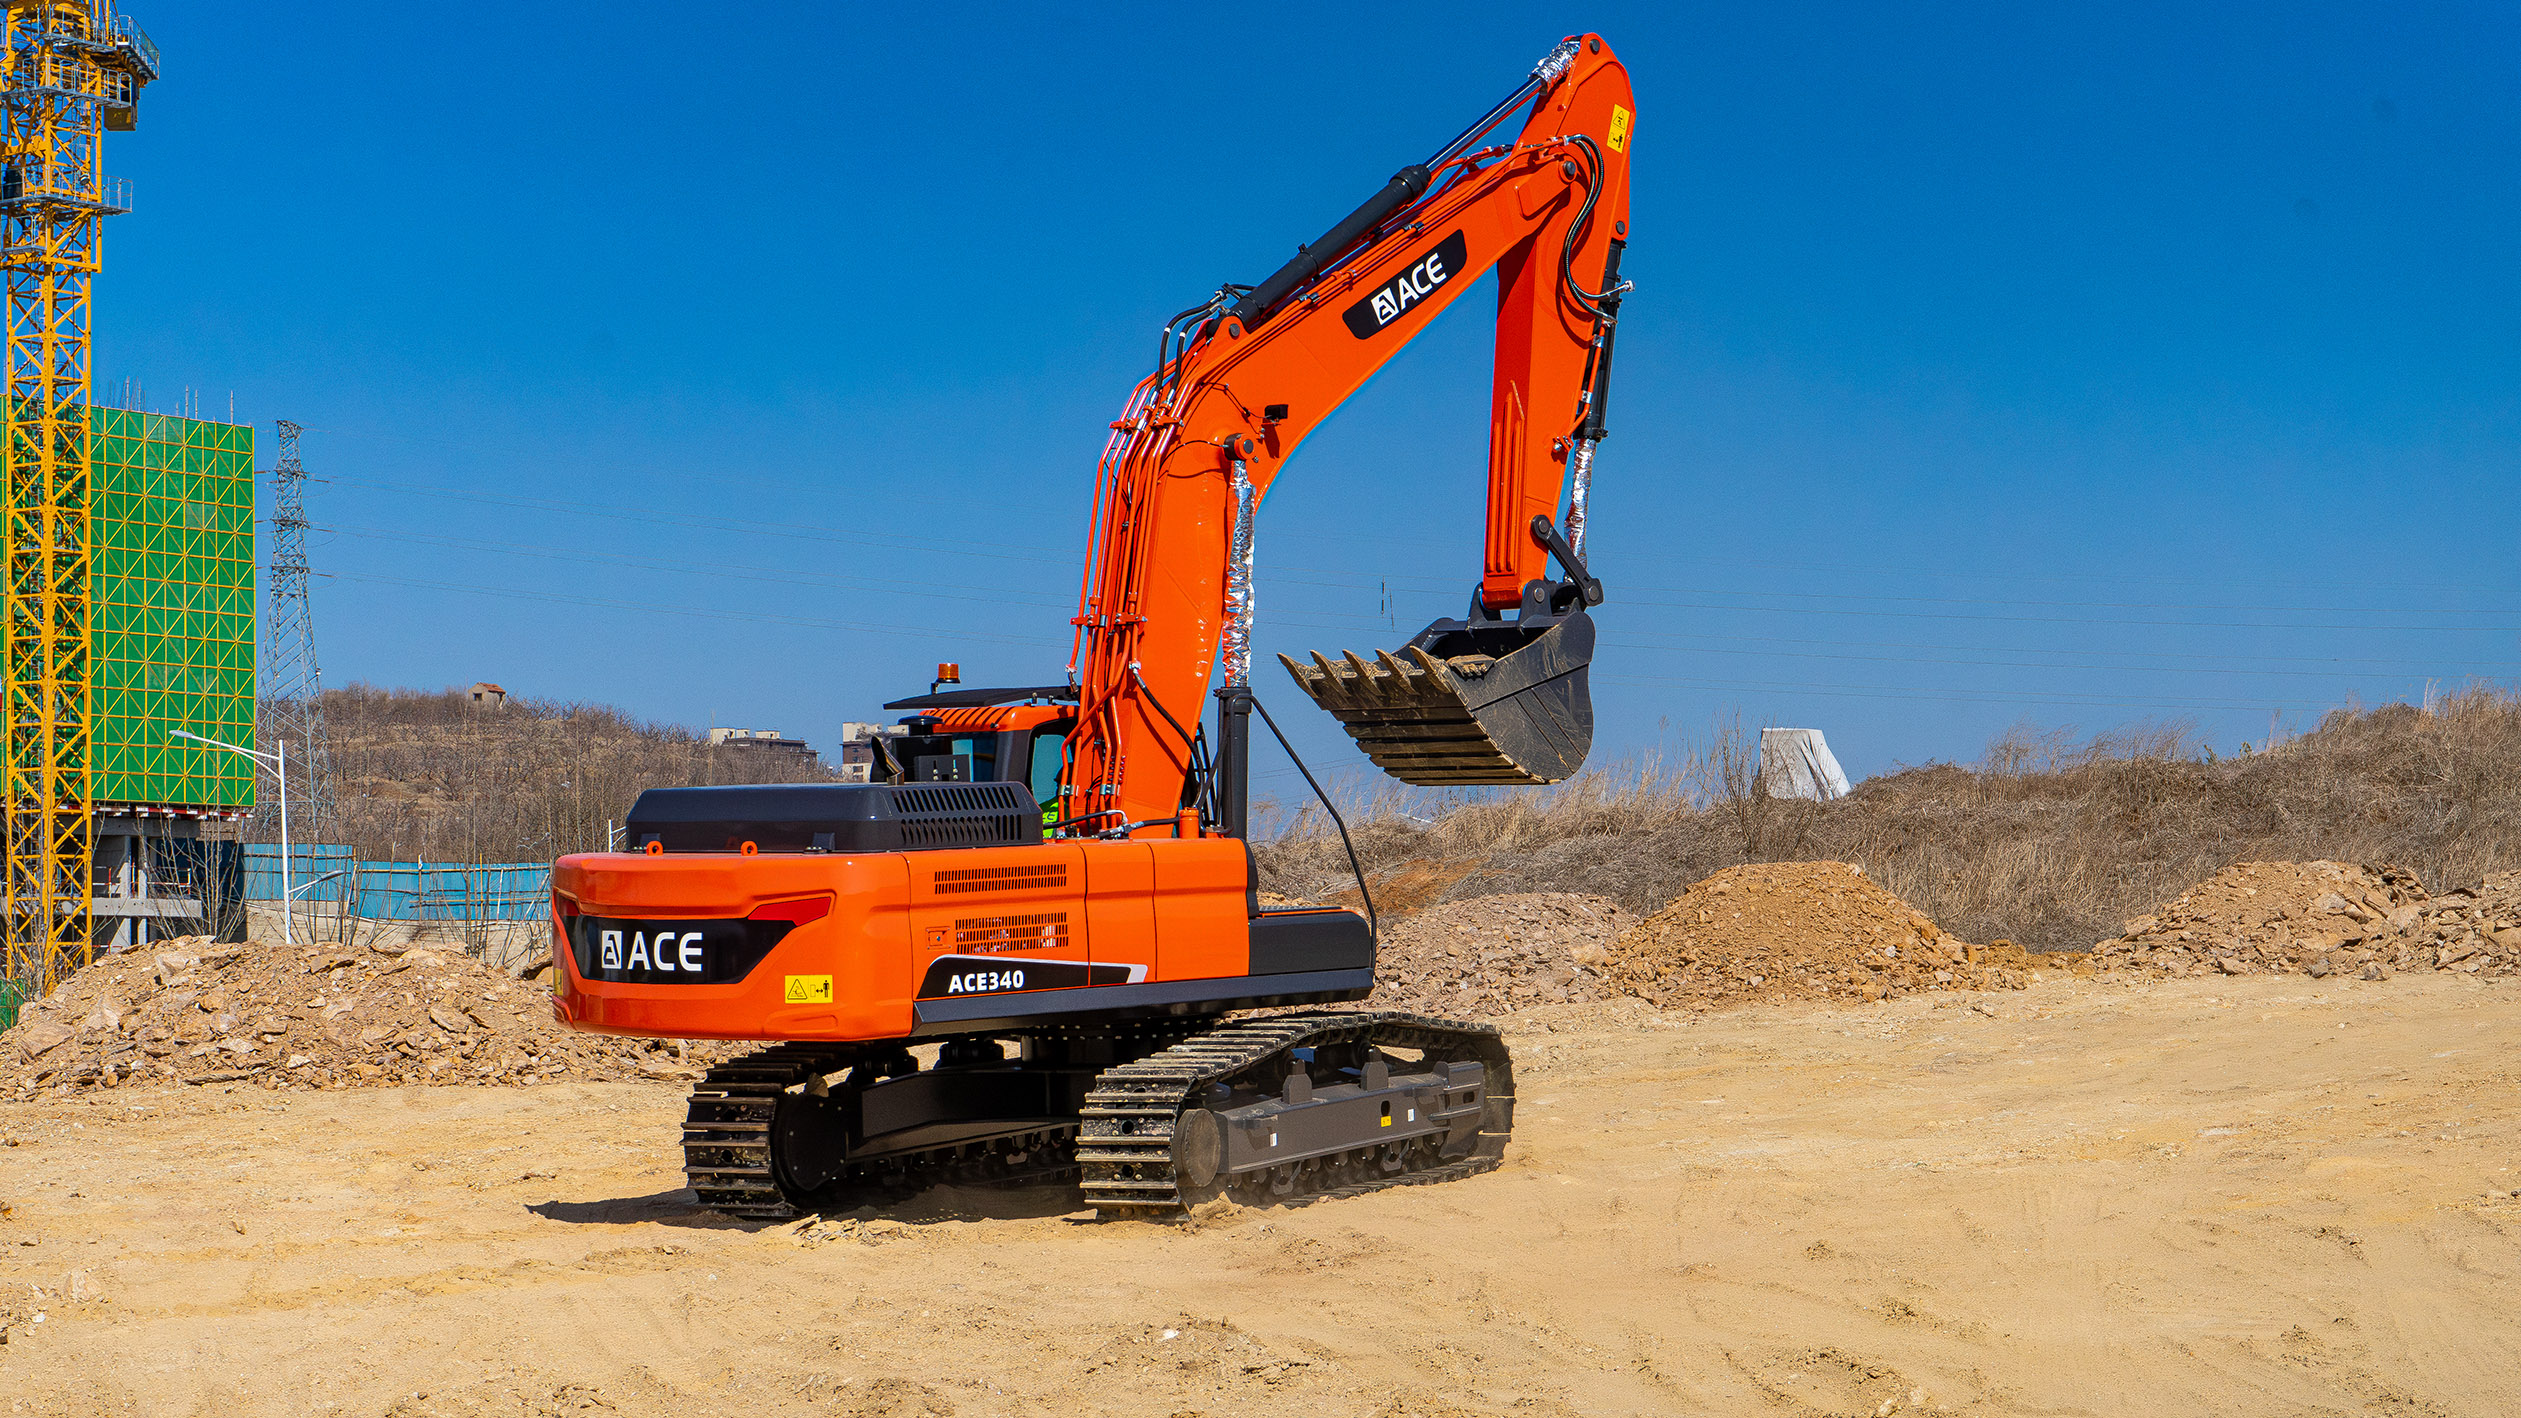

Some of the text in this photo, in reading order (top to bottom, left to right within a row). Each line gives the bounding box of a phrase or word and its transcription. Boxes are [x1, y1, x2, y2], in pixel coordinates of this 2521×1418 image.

[1399, 252, 1447, 310] ACE
[627, 931, 703, 972] ACE
[948, 970, 1024, 993] ACE340
